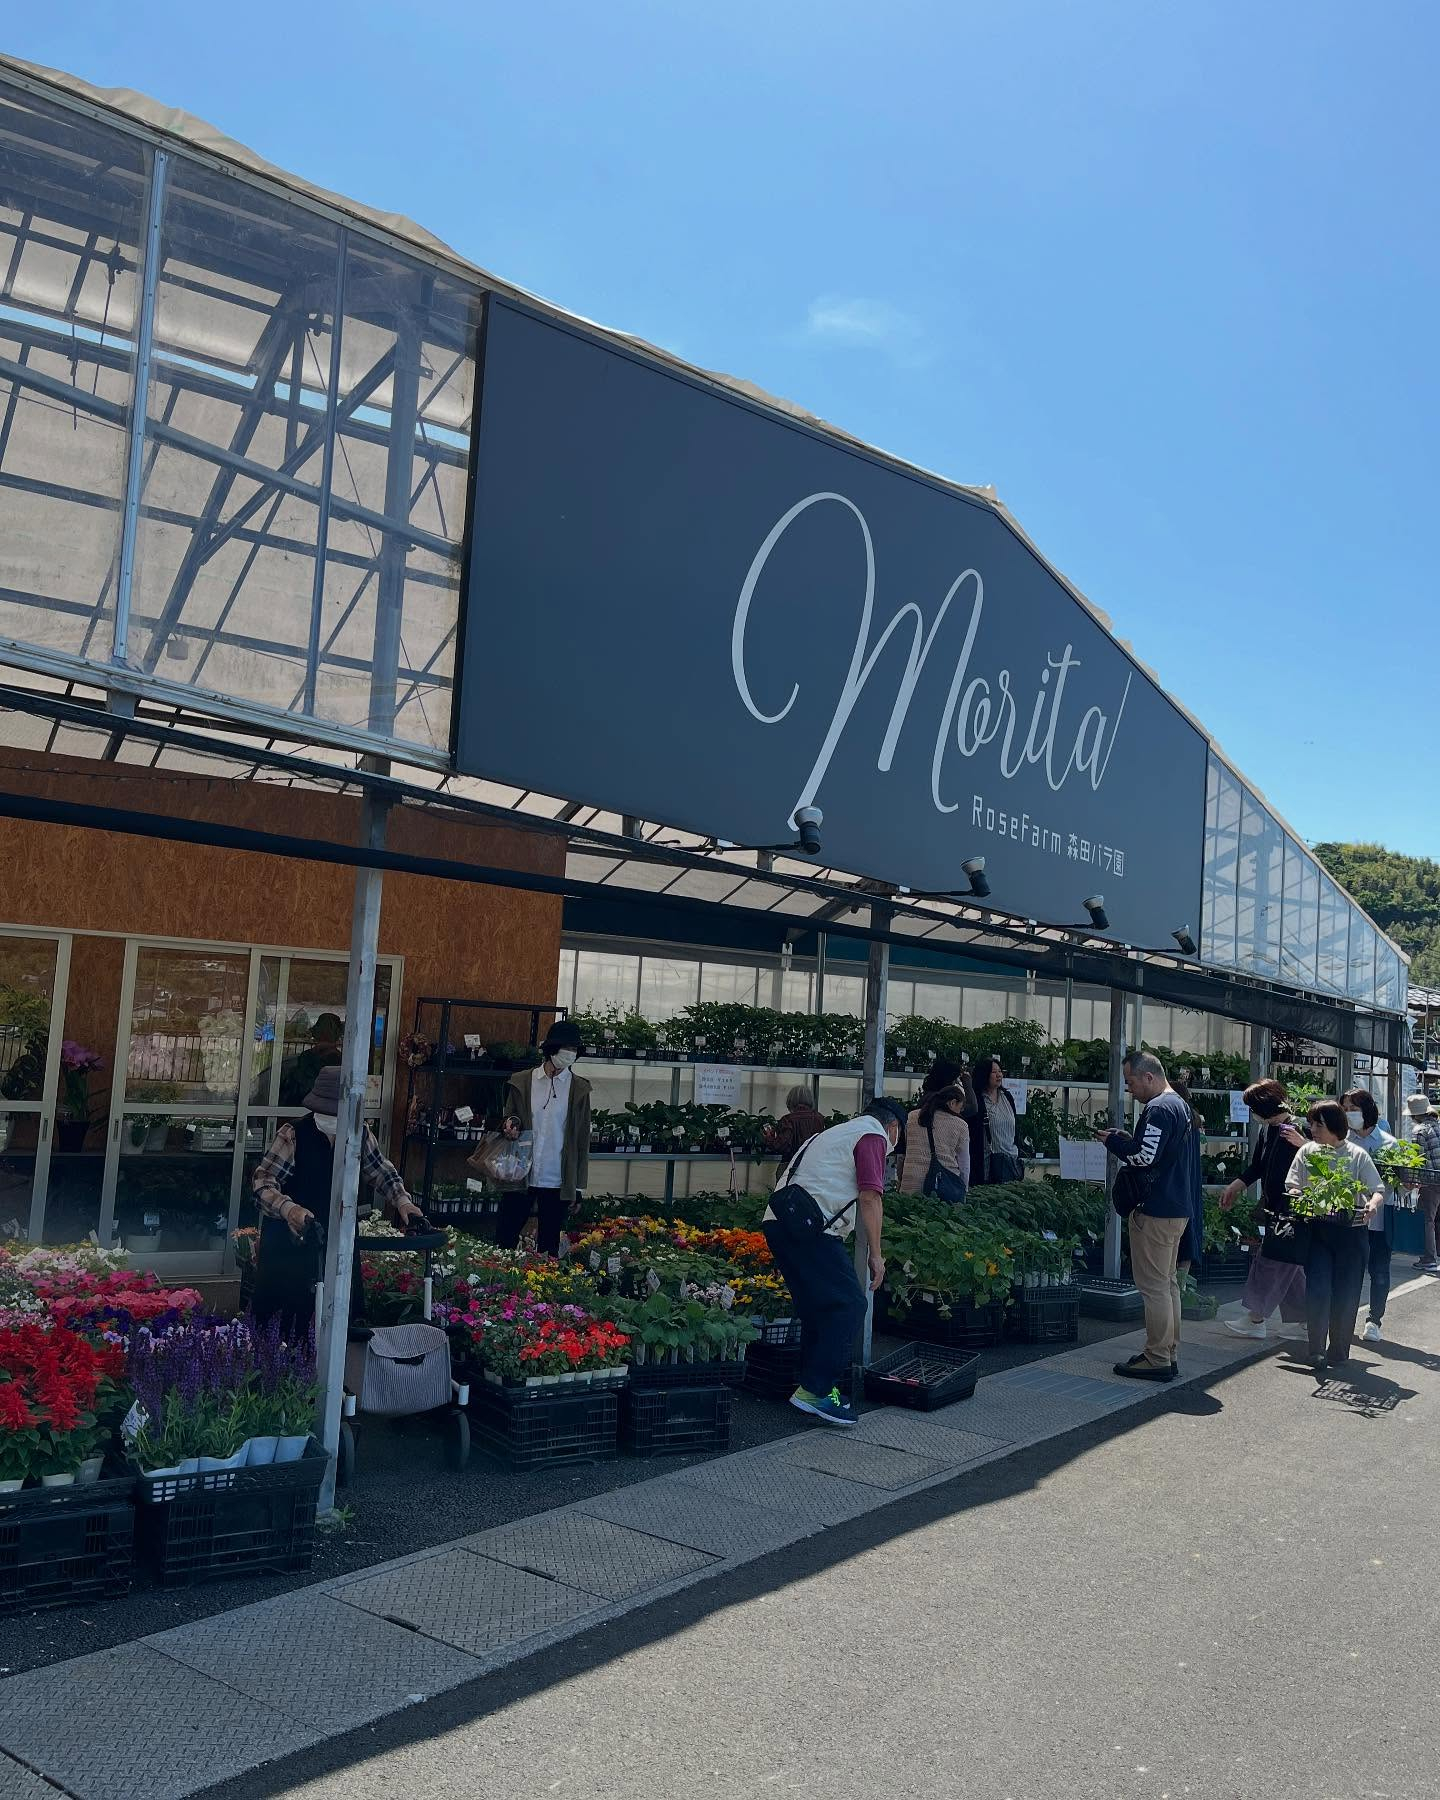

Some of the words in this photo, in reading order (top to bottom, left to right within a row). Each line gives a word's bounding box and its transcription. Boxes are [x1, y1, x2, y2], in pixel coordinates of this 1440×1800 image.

[732, 491, 1132, 832] Morita
[972, 795, 1062, 856] RoseFarm
[1067, 832, 1125, 877] 森田バラ園
